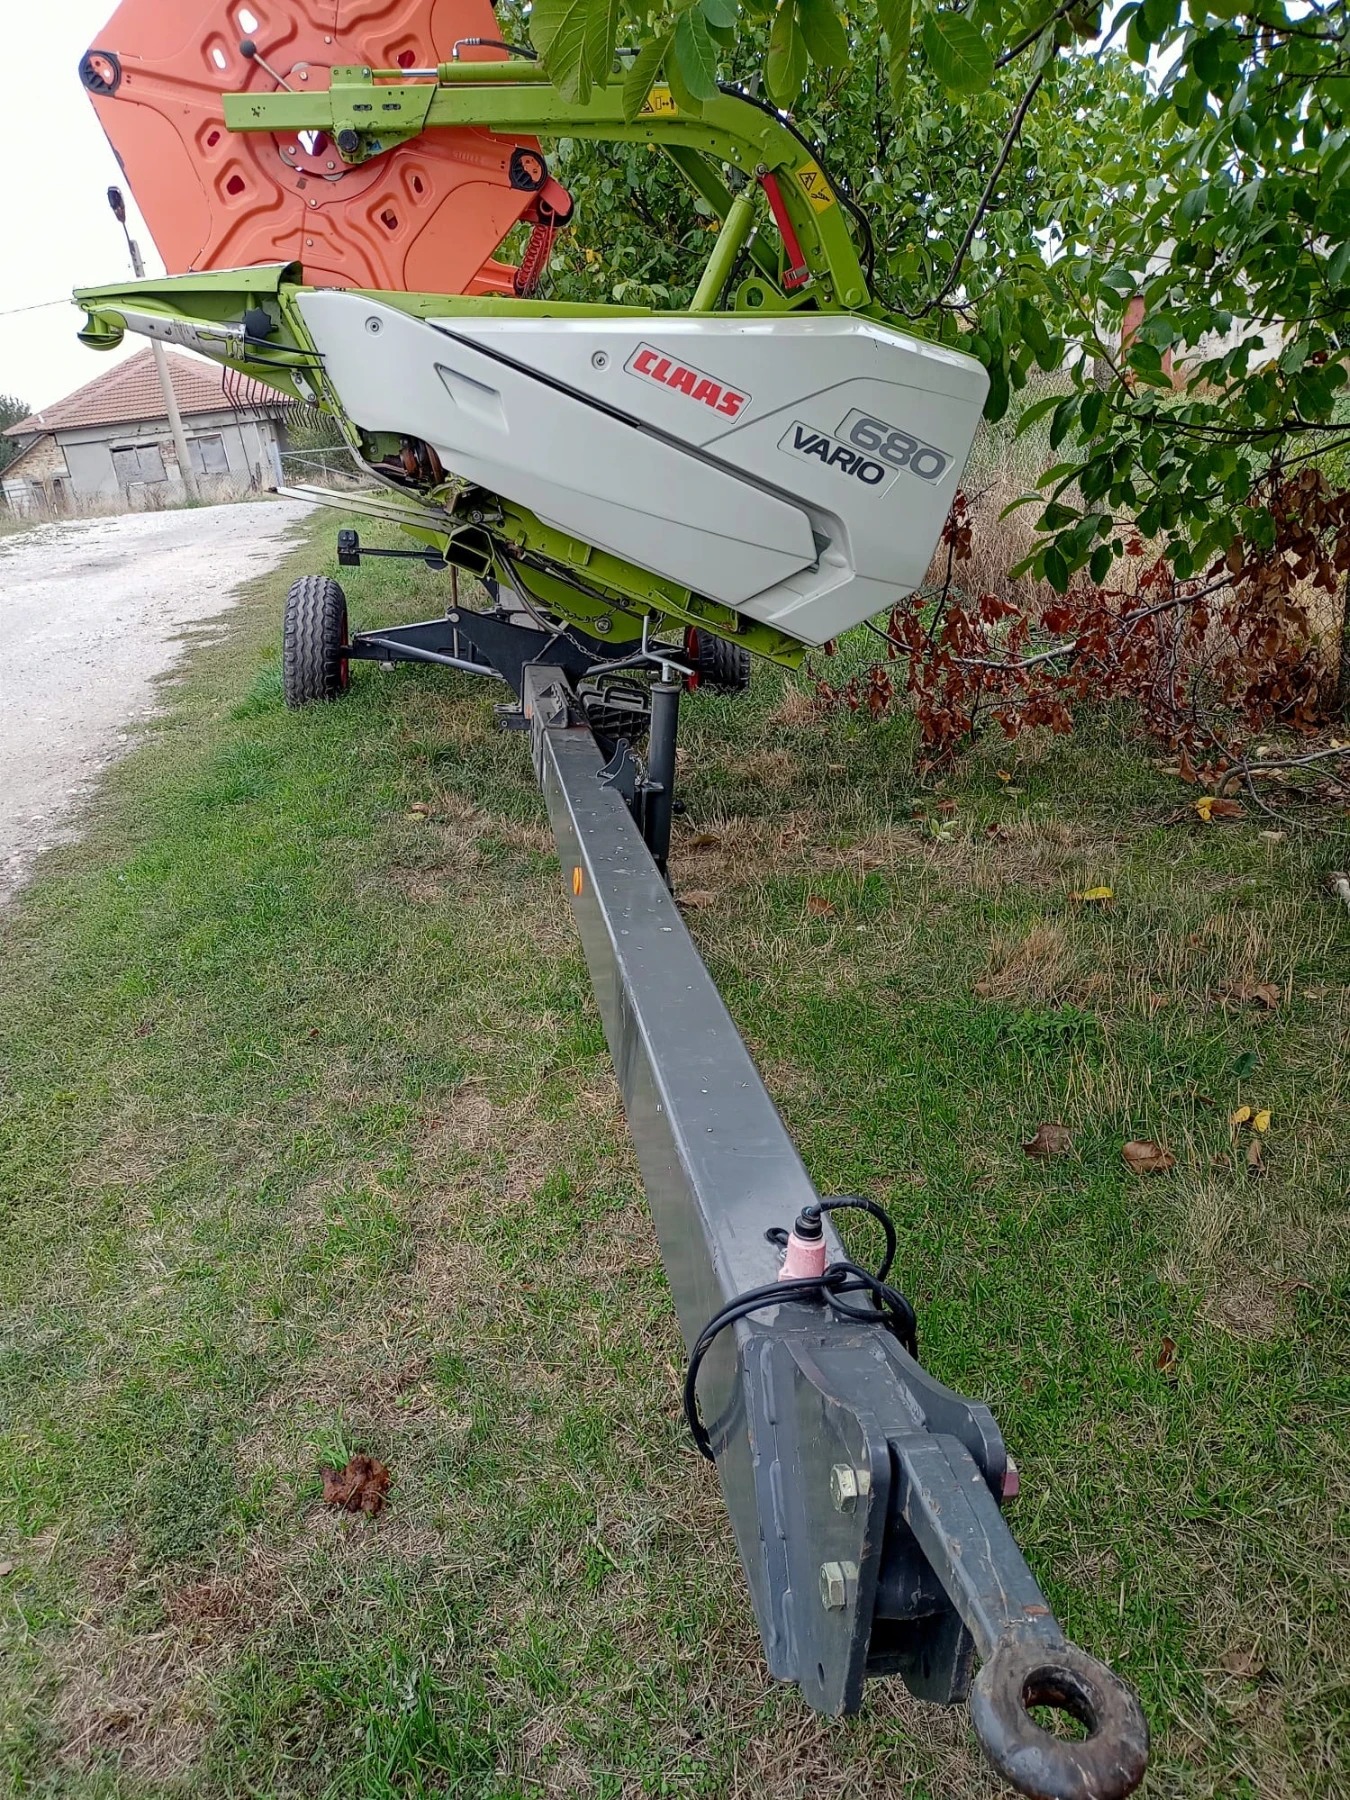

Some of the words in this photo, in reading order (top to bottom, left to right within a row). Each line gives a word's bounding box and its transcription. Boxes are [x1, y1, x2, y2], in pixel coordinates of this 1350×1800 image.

[633, 349, 744, 417] CLAAS
[792, 426, 886, 485] VARIO
[850, 418, 947, 480] 680
